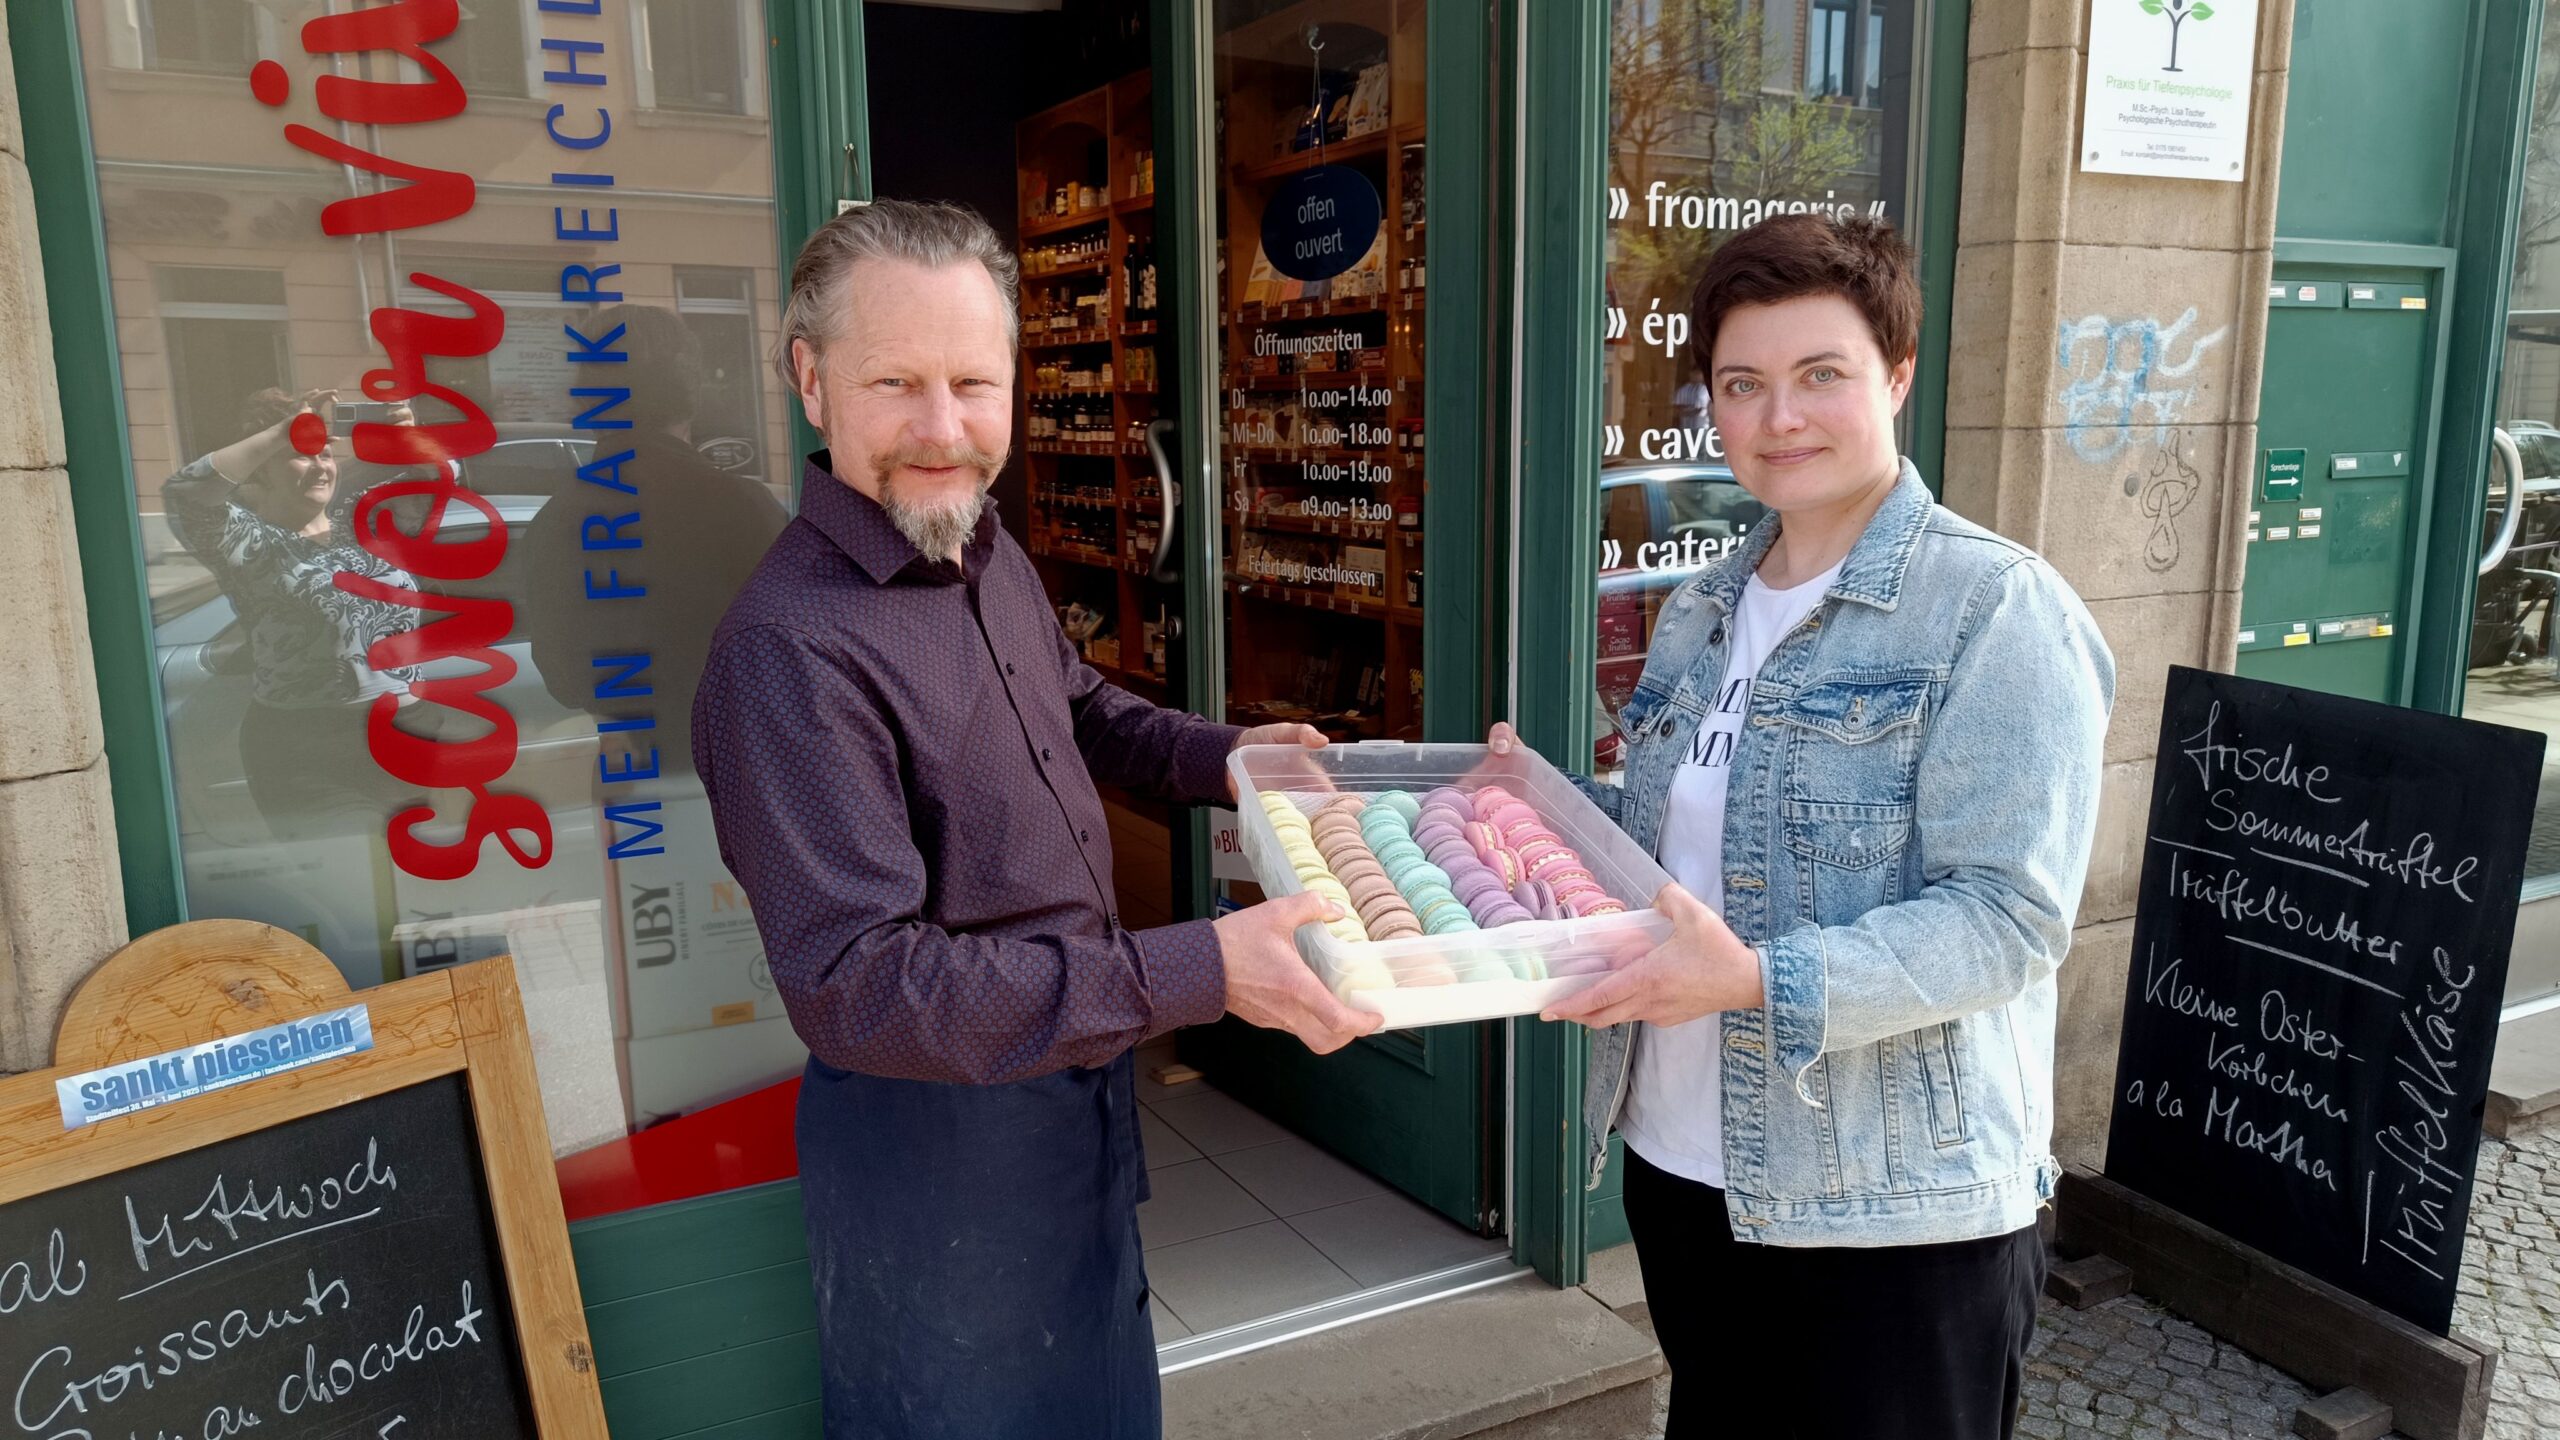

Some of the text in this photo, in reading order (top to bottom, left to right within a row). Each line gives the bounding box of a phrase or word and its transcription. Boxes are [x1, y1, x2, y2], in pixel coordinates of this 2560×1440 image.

[2105, 75, 2233, 102] Praxis für Tiefenpsychologie
[2118, 113, 2217, 130] Psychologische Psychotherapeutin
[2171, 106, 2183, 116] Lisa
[2185, 108, 2206, 118] Tischer
[1295, 227, 1343, 260] ouvert
[1298, 195, 1335, 224] offen
[1254, 328, 1363, 360] Öffnungszeiten
[1642, 298, 1692, 358] ép
[1232, 385, 1392, 409] Di 10.00-14.00
[1233, 422, 1392, 445] Mi-Do 10.00-18.00
[1233, 457, 1392, 483] Fr 10.00-19.00
[1234, 490, 1392, 521] Sa 09.00-13.00
[1249, 555, 1376, 587] Feiertags geschlossen
[591, 652, 666, 861] MEIN
[2180, 699, 2342, 803] frische
[2206, 788, 2478, 903] Sommertrüffel
[631, 883, 677, 970] UBY
[2150, 836, 2403, 965] Trüffelbutter
[2146, 941, 2239, 1027] Kleine
[2260, 989, 2367, 1063] Oster-
[81, 1017, 354, 1111] sankt pieschen
[142, 1098, 155, 1108] Mai
[181, 1086, 199, 1098] 2025
[203, 1070, 261, 1092] sanktpieschen.de
[265, 1045, 356, 1075] facebook.com/sanktpieschen
[2208, 1031, 2348, 1122] Körbchen
[2156, 1080, 2184, 1118] la
[2204, 1086, 2336, 1191] Martha
[0, 1136, 397, 1313] ab Mittwoch
[14, 1268, 351, 1432] Croissants
[278, 1279, 483, 1414] chocolat
